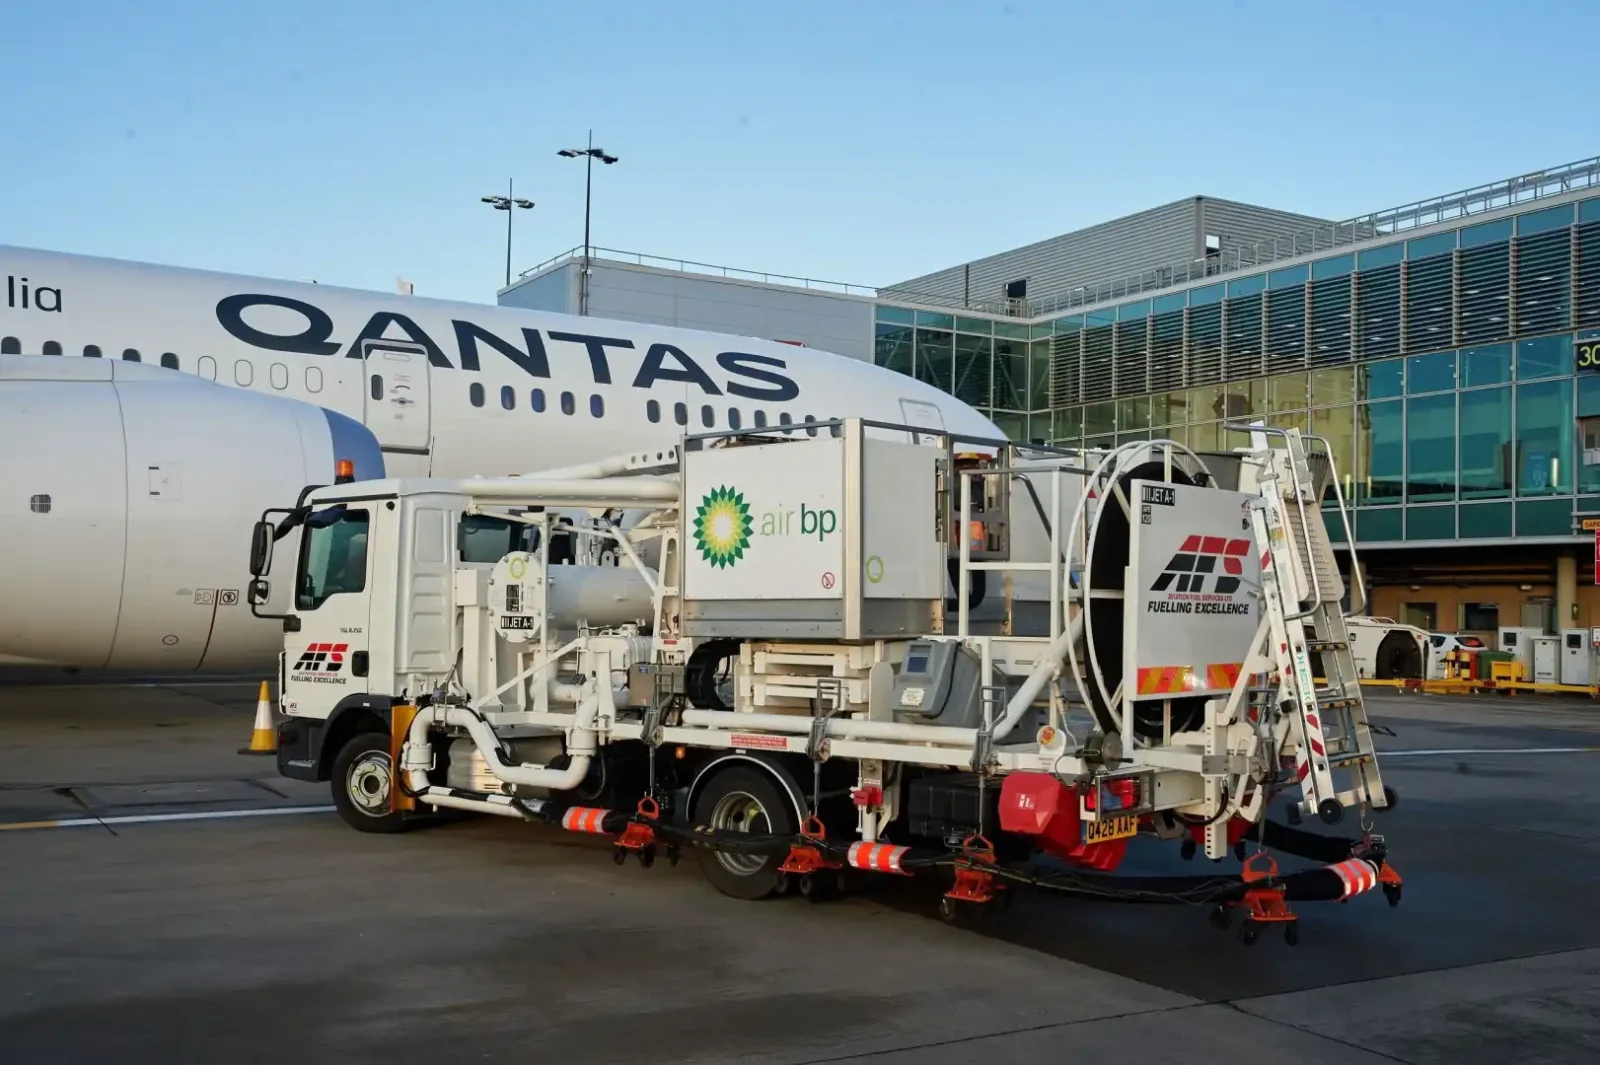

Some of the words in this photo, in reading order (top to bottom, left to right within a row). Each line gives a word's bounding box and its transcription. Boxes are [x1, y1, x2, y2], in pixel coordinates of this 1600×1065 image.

[216, 293, 800, 401] QANTAS
[1151, 488, 1164, 502] JET
[1164, 490, 1175, 504] A-1
[761, 509, 794, 536] air
[801, 503, 836, 542] bp
[1148, 601, 1192, 613] FUELLING
[1194, 602, 1249, 615] EXCELLENCE
[510, 617, 522, 628] JET
[522, 617, 533, 628] A-1
[314, 676, 346, 684] EXCELLENCE
